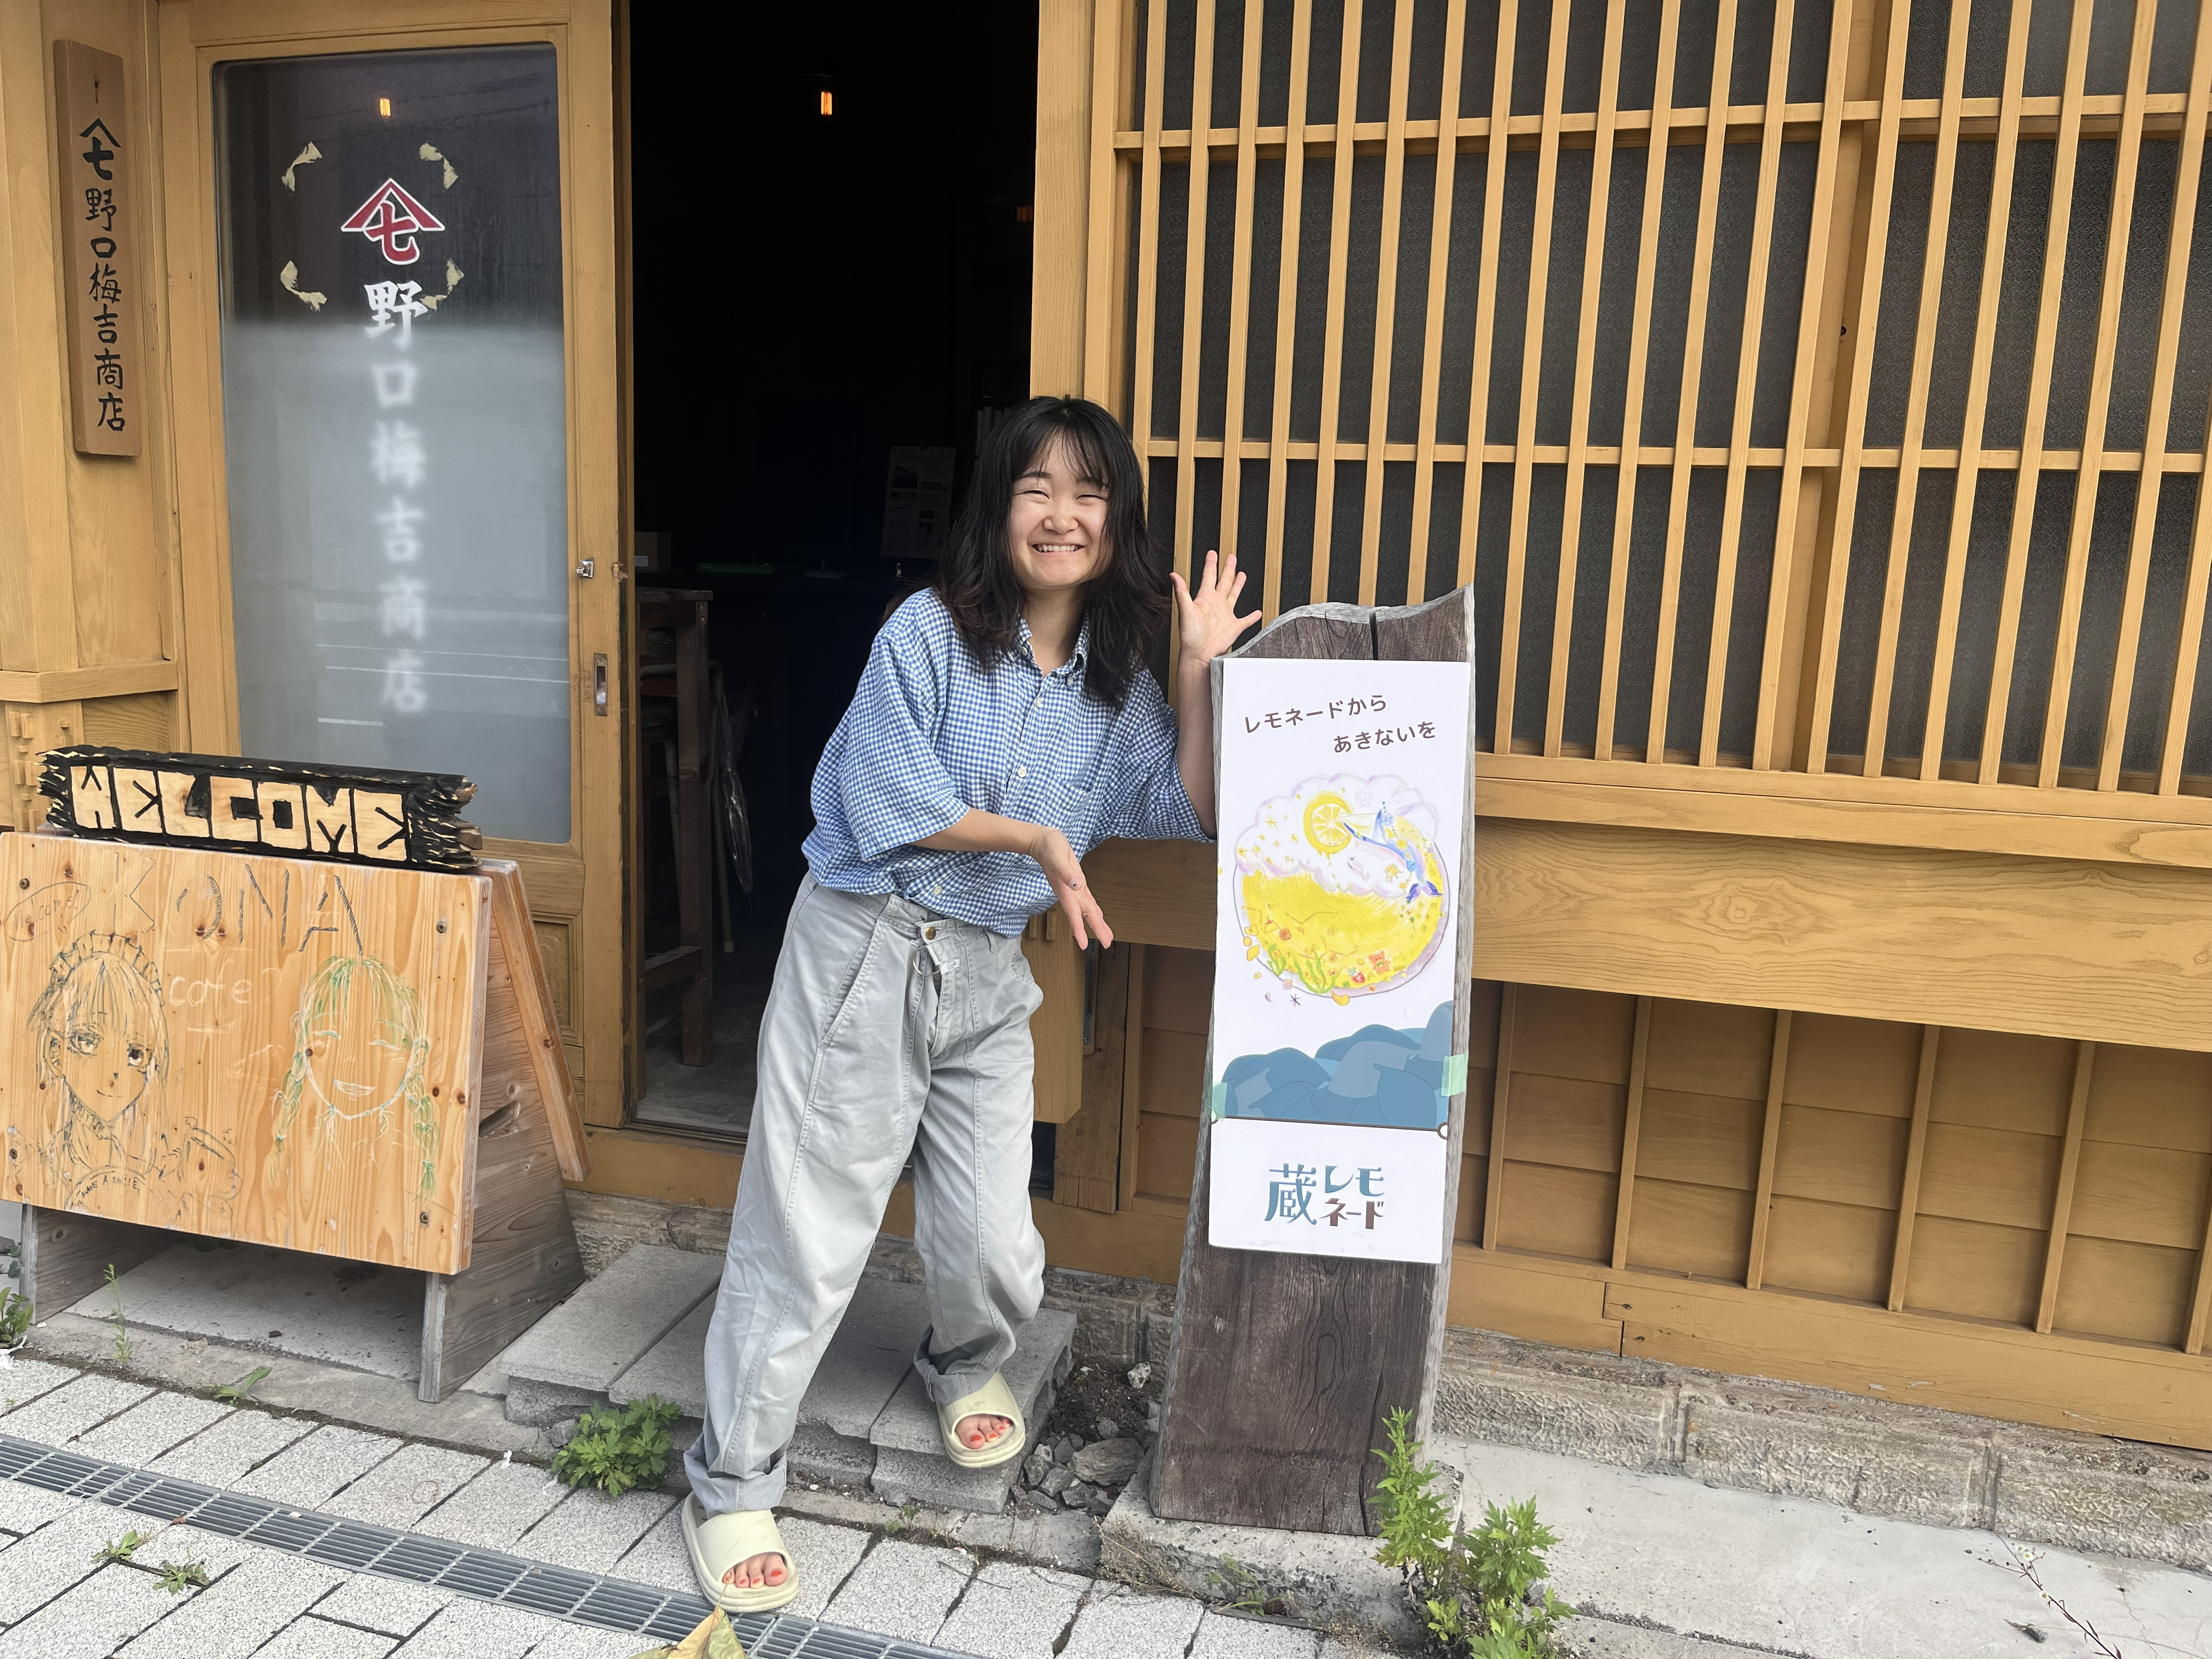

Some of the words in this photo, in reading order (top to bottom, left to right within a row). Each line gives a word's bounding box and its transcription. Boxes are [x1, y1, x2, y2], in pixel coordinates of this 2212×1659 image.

[84, 188, 126, 432] 野口梅吉商店
[1245, 695, 1386, 733] レモネードから
[1334, 721, 1436, 753] あきないを
[70, 765, 408, 862] WELCOME
